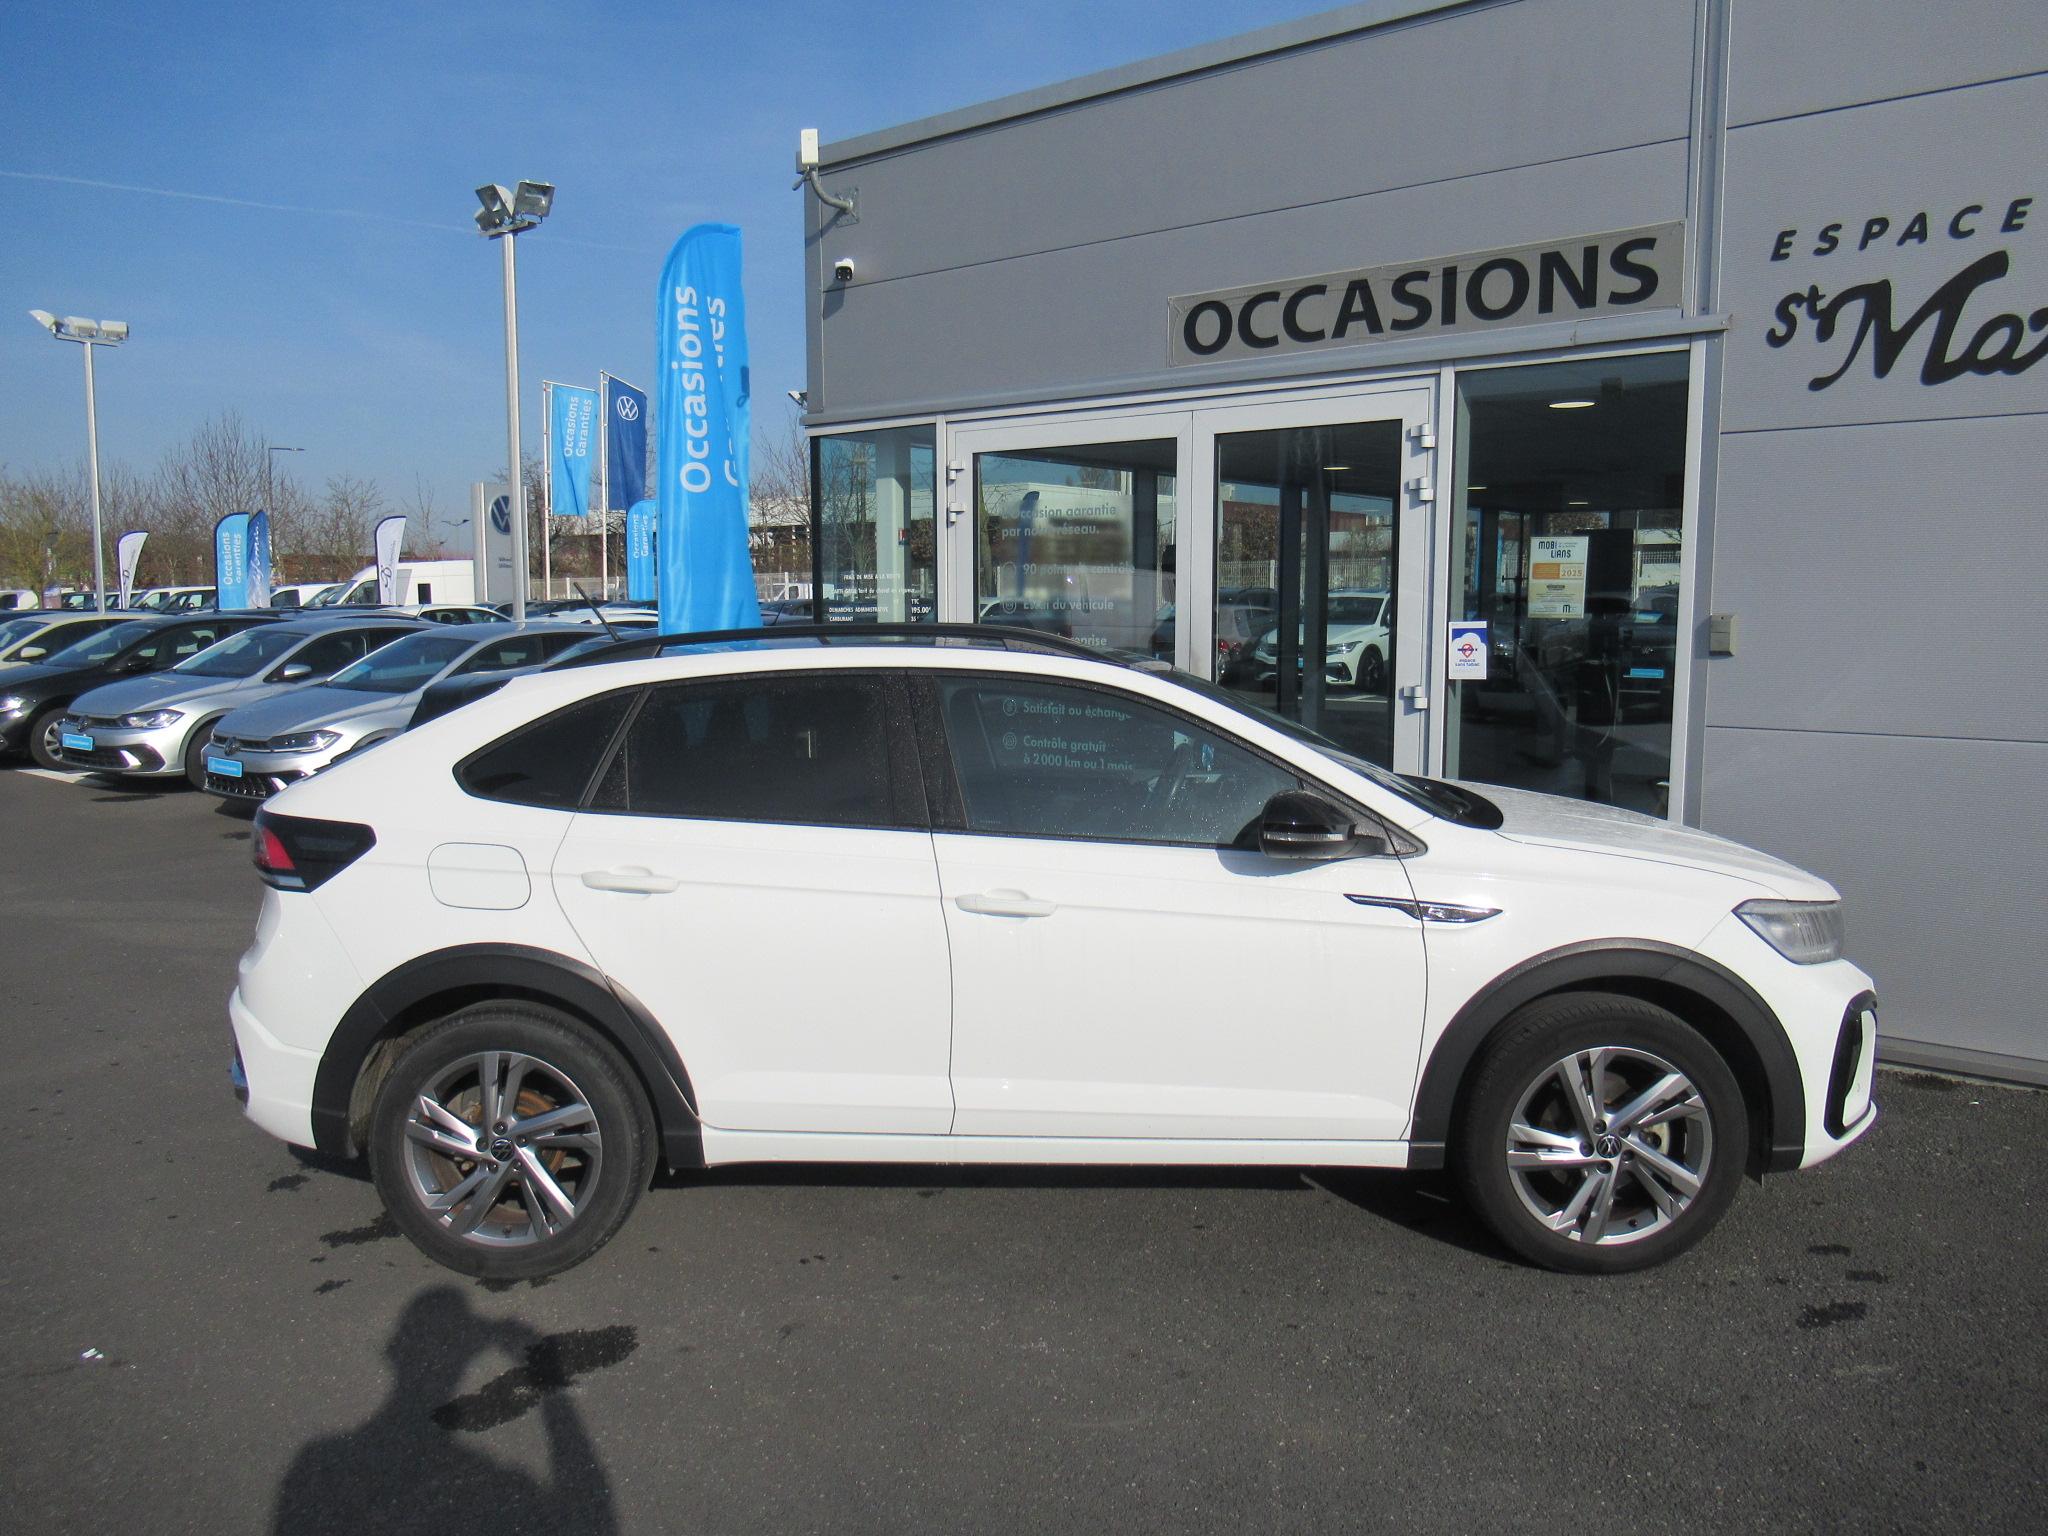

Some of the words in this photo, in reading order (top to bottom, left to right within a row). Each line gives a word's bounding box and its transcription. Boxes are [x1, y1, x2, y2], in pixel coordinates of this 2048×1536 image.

[1770, 198, 2033, 262] ESPACE
[1183, 236, 1660, 356] OCCASIONS
[671, 285, 712, 494] Occasions
[563, 396, 579, 457] Occasions
[576, 399, 593, 457] Garanties
[632, 513, 640, 559] Occasions
[1001, 527, 1020, 541] par
[223, 531, 233, 585] Occasions
[1023, 563, 1037, 576] 90
[1550, 549, 1572, 559] LIANS
[1052, 599, 1066, 610] du
[1070, 598, 1115, 610] véhicule
[1023, 701, 1066, 716] Satisfait
[1068, 707, 1082, 716] ou
[1023, 735, 1067, 750] Contrôle
[1070, 740, 1107, 753] gratuit
[1023, 752, 1031, 766] à
[1064, 755, 1081, 768] km
[1083, 761, 1097, 770] ou
